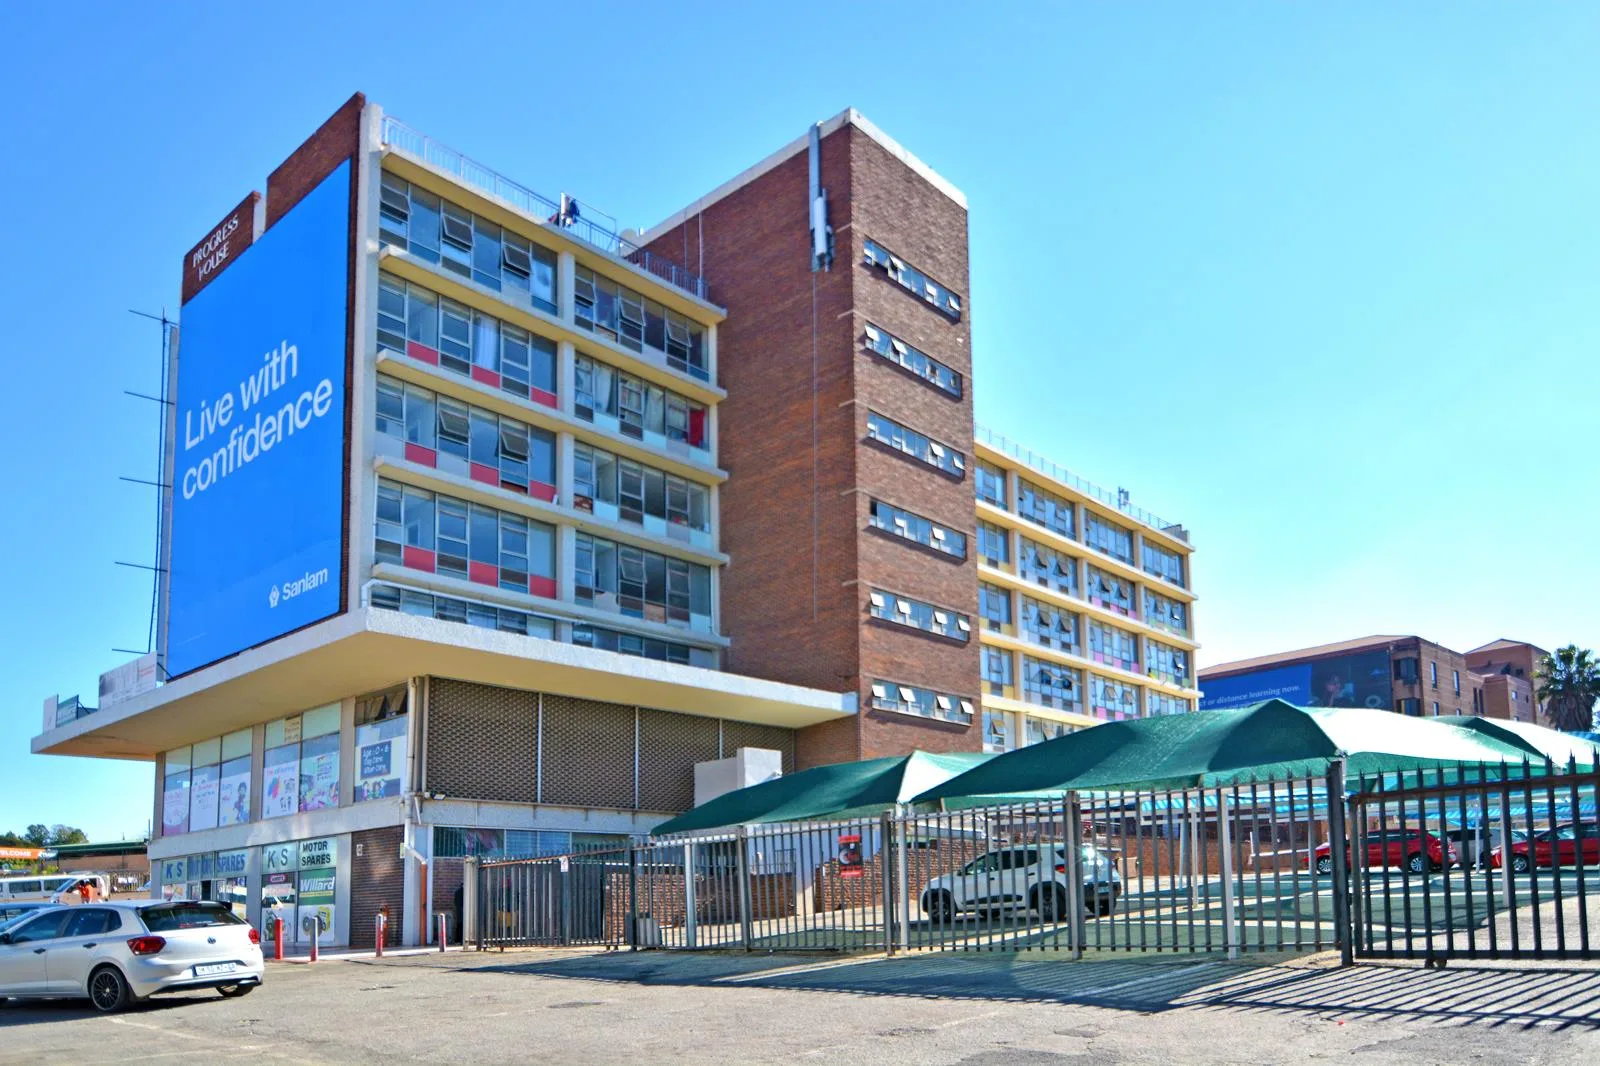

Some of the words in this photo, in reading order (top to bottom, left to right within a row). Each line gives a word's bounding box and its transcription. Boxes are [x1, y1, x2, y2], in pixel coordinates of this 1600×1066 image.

[193, 214, 239, 268] PROGRESS
[184, 392, 234, 451] Live
[240, 339, 298, 411] with
[182, 378, 333, 500] confidence
[282, 568, 328, 600] Sanlam
[1216, 693, 1248, 704] distance
[1248, 688, 1281, 698] learning
[302, 840, 329, 852] MOTOR
[217, 854, 246, 873] SPARES
[267, 850, 276, 868] K
[280, 848, 289, 866] S
[301, 853, 332, 867] SPARES
[300, 876, 336, 892] Willard
